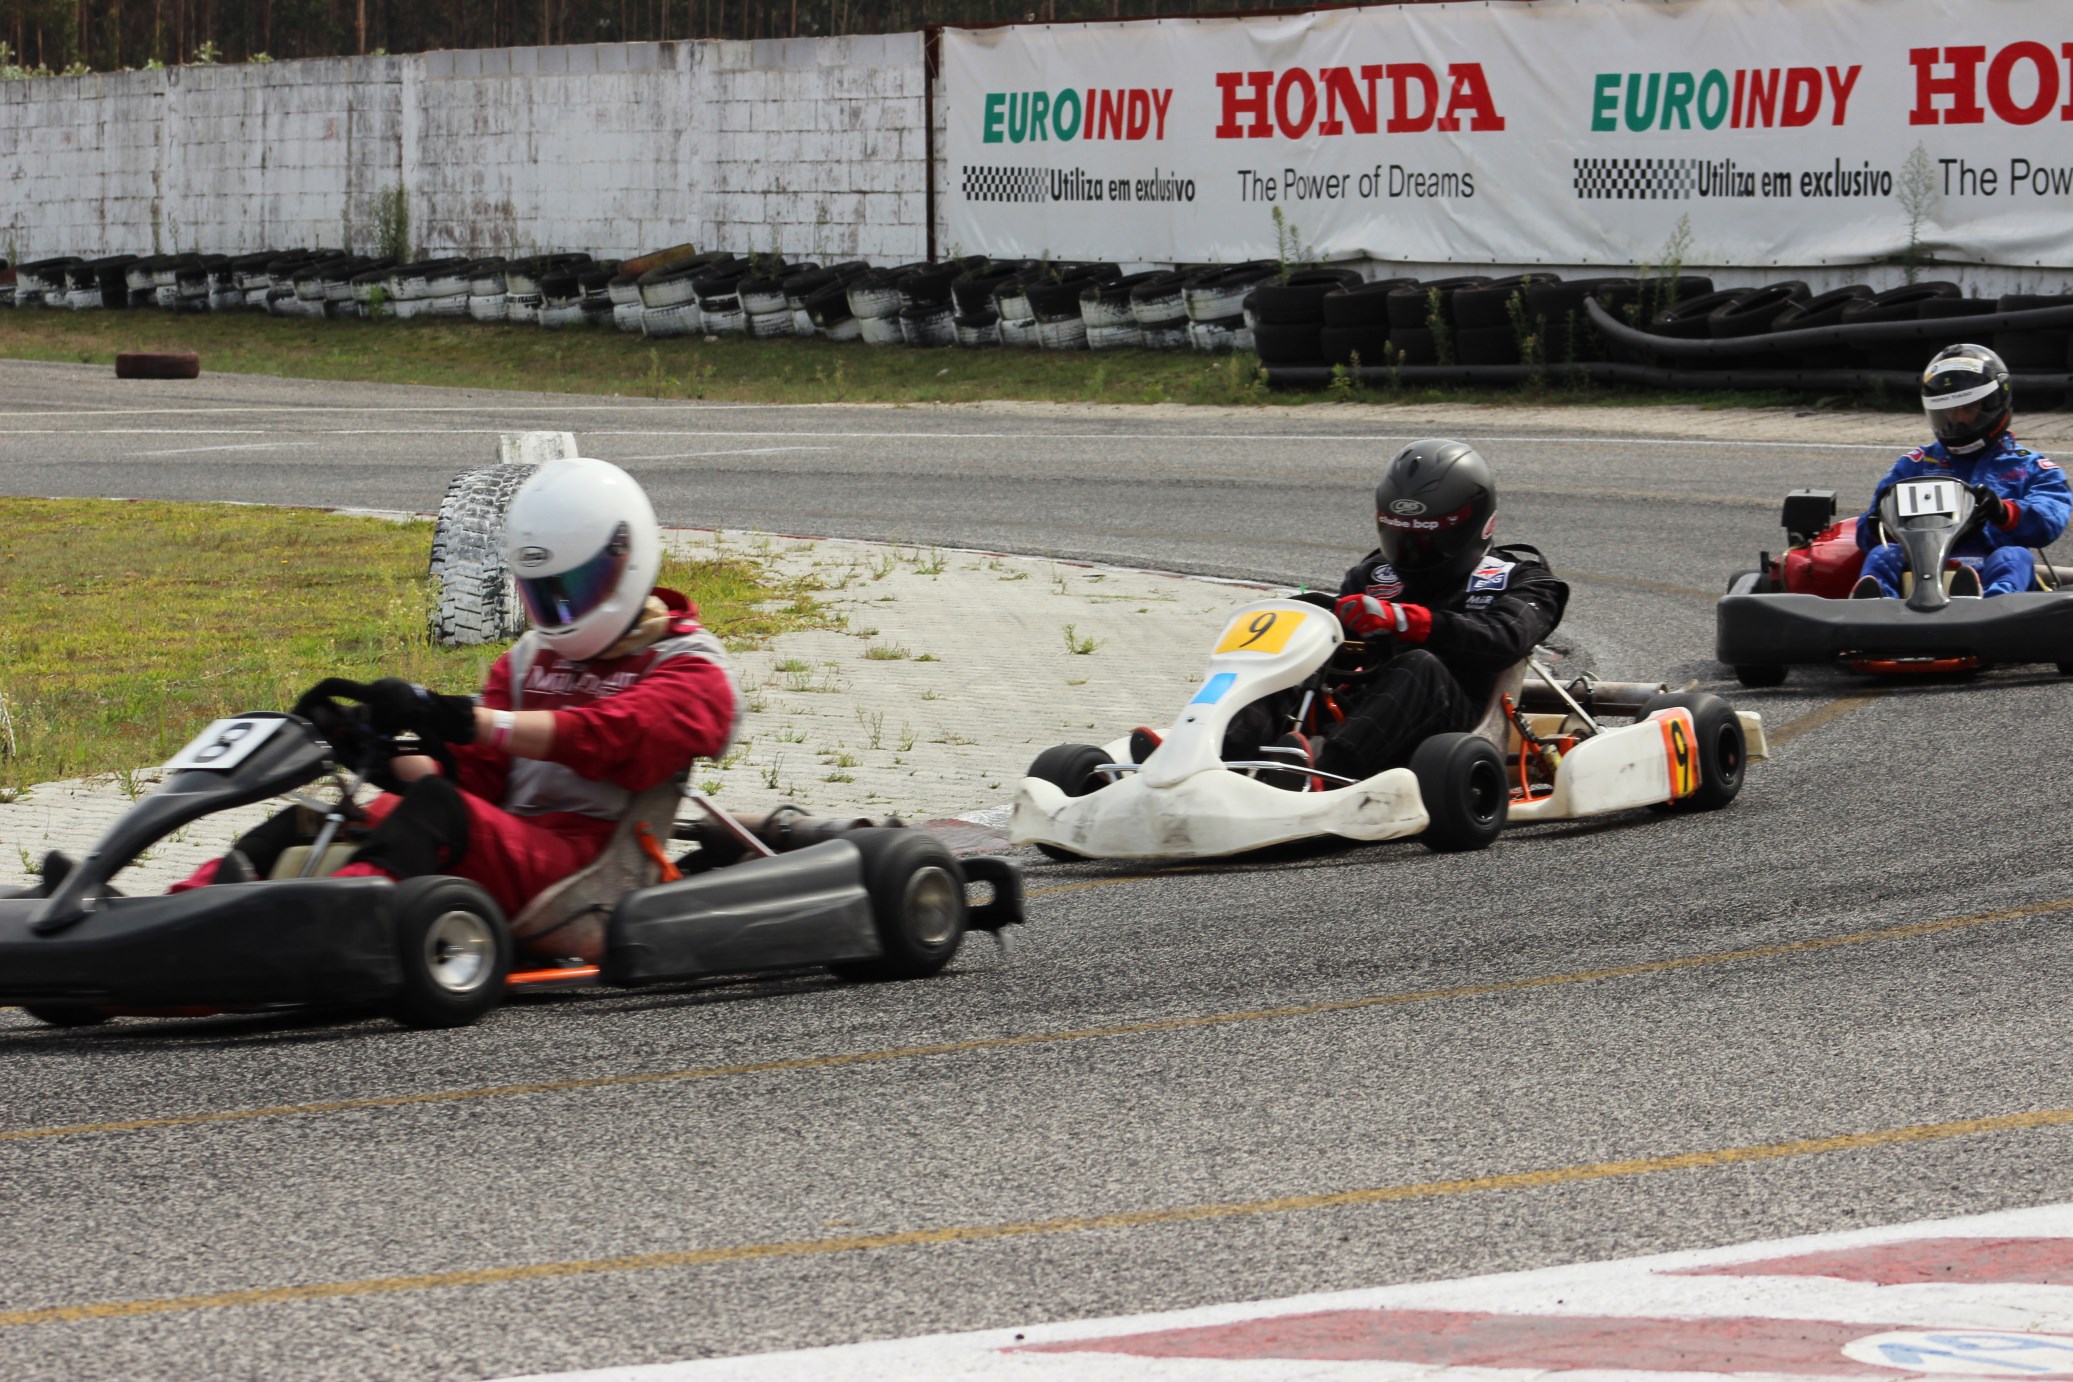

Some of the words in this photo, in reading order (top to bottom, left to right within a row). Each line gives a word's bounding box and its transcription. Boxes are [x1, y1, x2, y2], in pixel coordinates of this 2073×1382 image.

[1215, 62, 1506, 140] HONDA
[1590, 65, 1862, 132] EUROINDY
[1908, 41, 2073, 125] HO
[983, 87, 1174, 144] EUROINDY
[1050, 167, 1103, 201] Utiliza
[1108, 178, 1131, 201] em
[1135, 167, 1196, 201] exclusivo
[1237, 169, 1277, 202] The
[1284, 168, 1350, 200] Power
[1358, 165, 1382, 200] of
[1389, 164, 1475, 199] Dreams
[1698, 158, 1755, 198] Utiliza
[1761, 167, 1792, 198] em
[1799, 157, 1893, 198] exclusivo
[1937, 158, 1998, 197] The
[1413, 519, 1439, 531] bcp
[1239, 612, 1277, 648] 9
[193, 721, 255, 764] 8
[1670, 719, 1690, 793] 9
